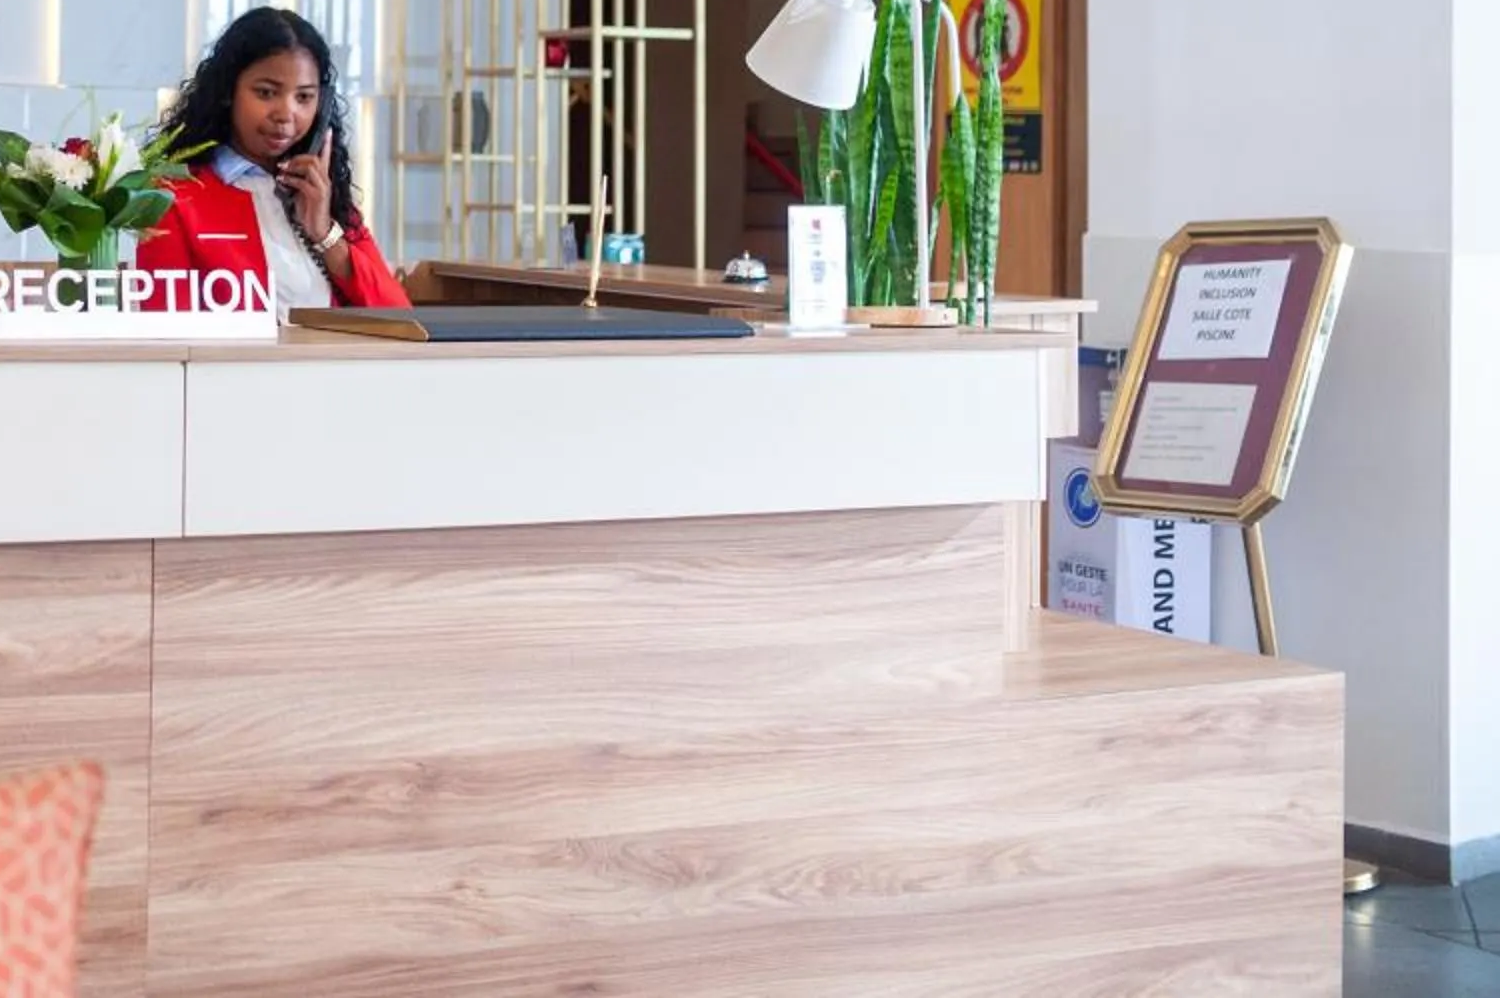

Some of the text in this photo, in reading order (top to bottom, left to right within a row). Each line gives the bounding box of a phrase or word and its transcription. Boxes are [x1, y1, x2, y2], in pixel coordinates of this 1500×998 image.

[1203, 267, 1262, 281] HUMANITY
[1198, 287, 1258, 300] INCLUSION
[1192, 308, 1253, 322] SALLE COTE
[1196, 329, 1236, 341] PISCINE
[1058, 560, 1109, 582] UN GESTE
[1153, 569, 1174, 634] AND
